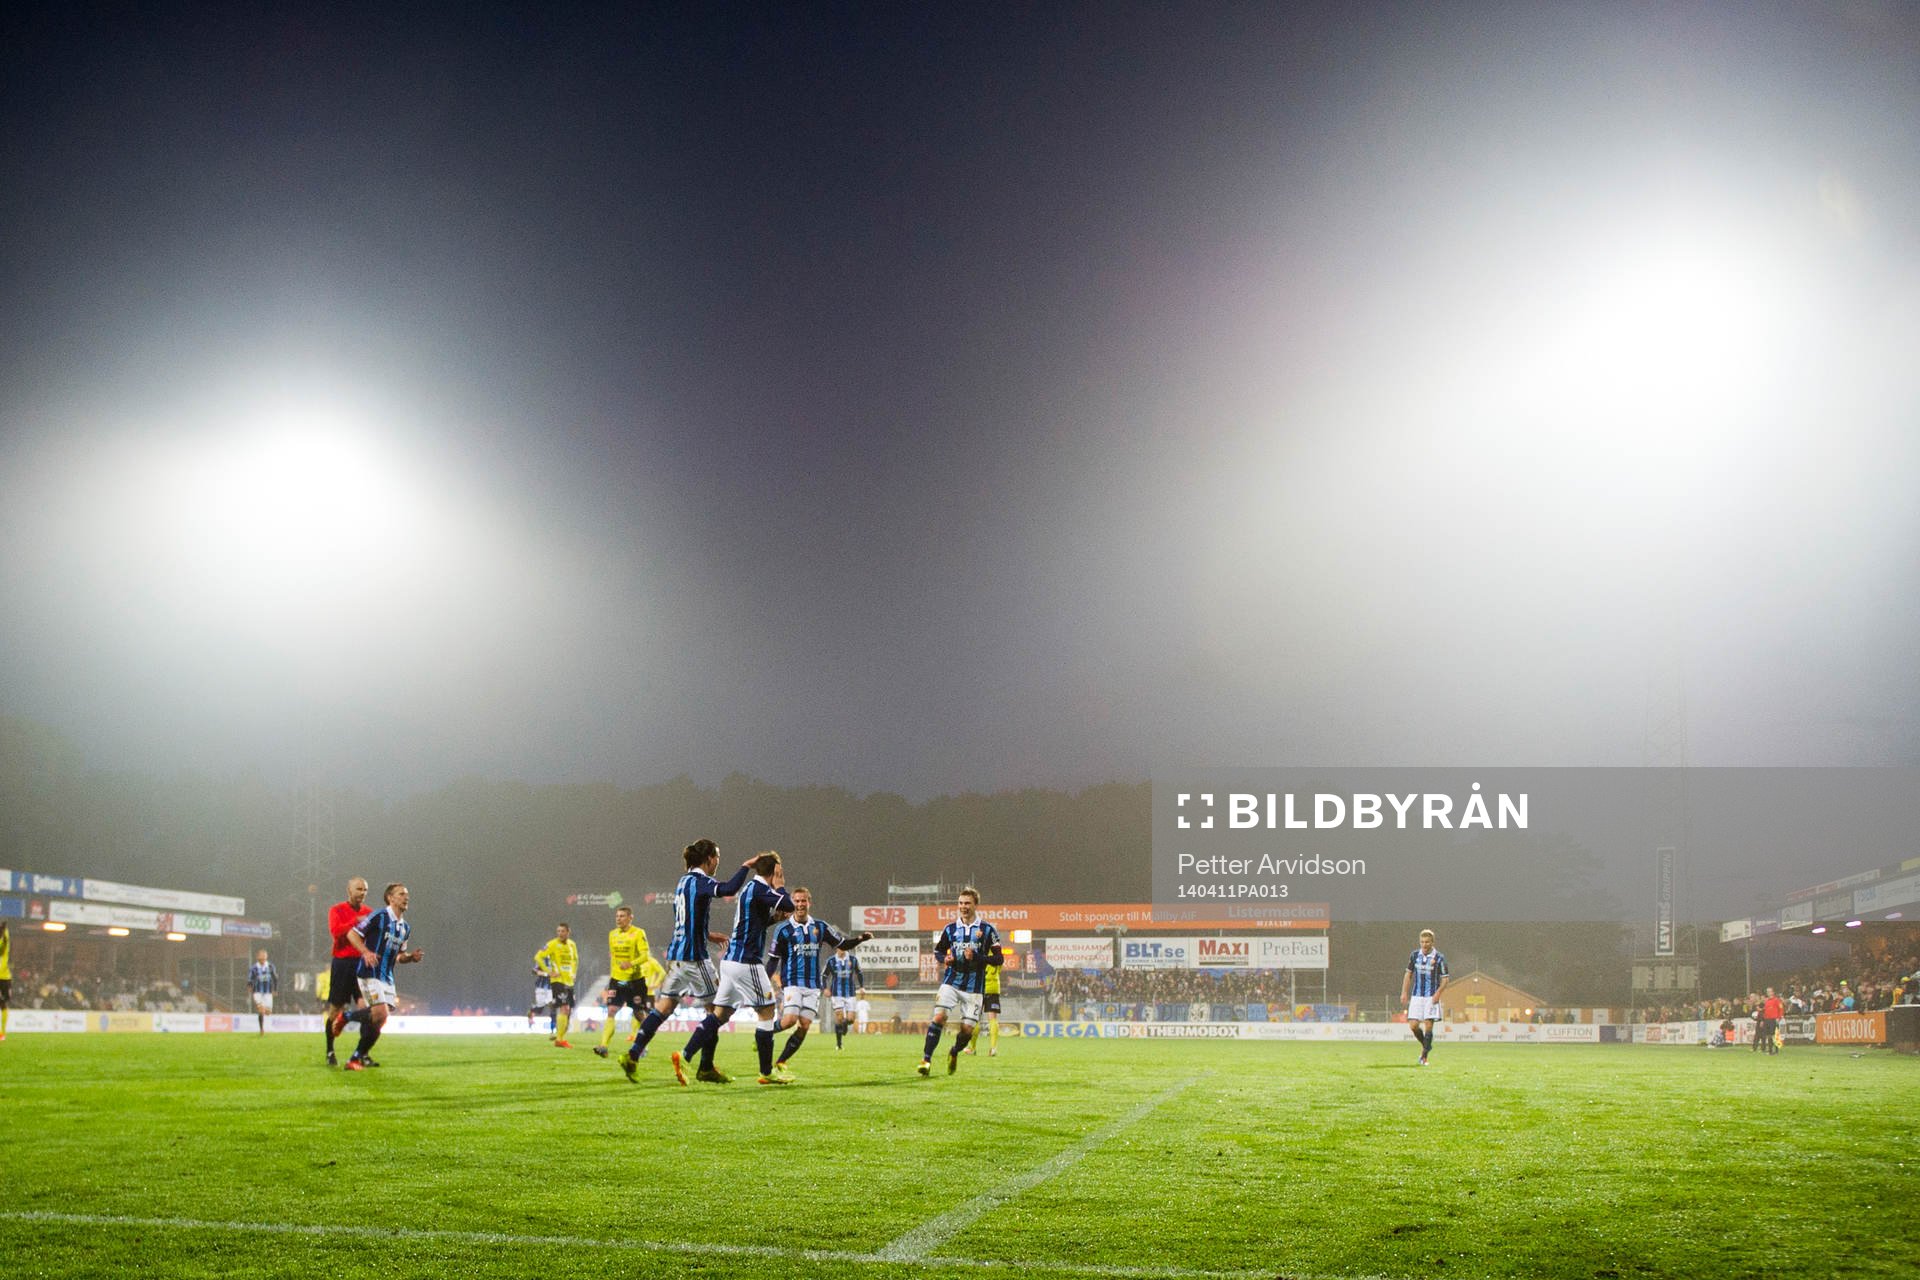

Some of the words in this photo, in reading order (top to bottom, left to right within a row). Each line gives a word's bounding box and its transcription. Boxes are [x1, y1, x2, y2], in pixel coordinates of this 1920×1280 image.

[1060, 911, 1081, 922] Stolt
[1084, 912, 1124, 923] sponsor
[1127, 911, 1139, 920] till
[1228, 905, 1324, 918] Listermacken
[1262, 941, 1324, 956] PreFast
[1147, 1025, 1239, 1038] THERMOBOX
[1823, 1015, 1876, 1040] SÖLVESBORG
